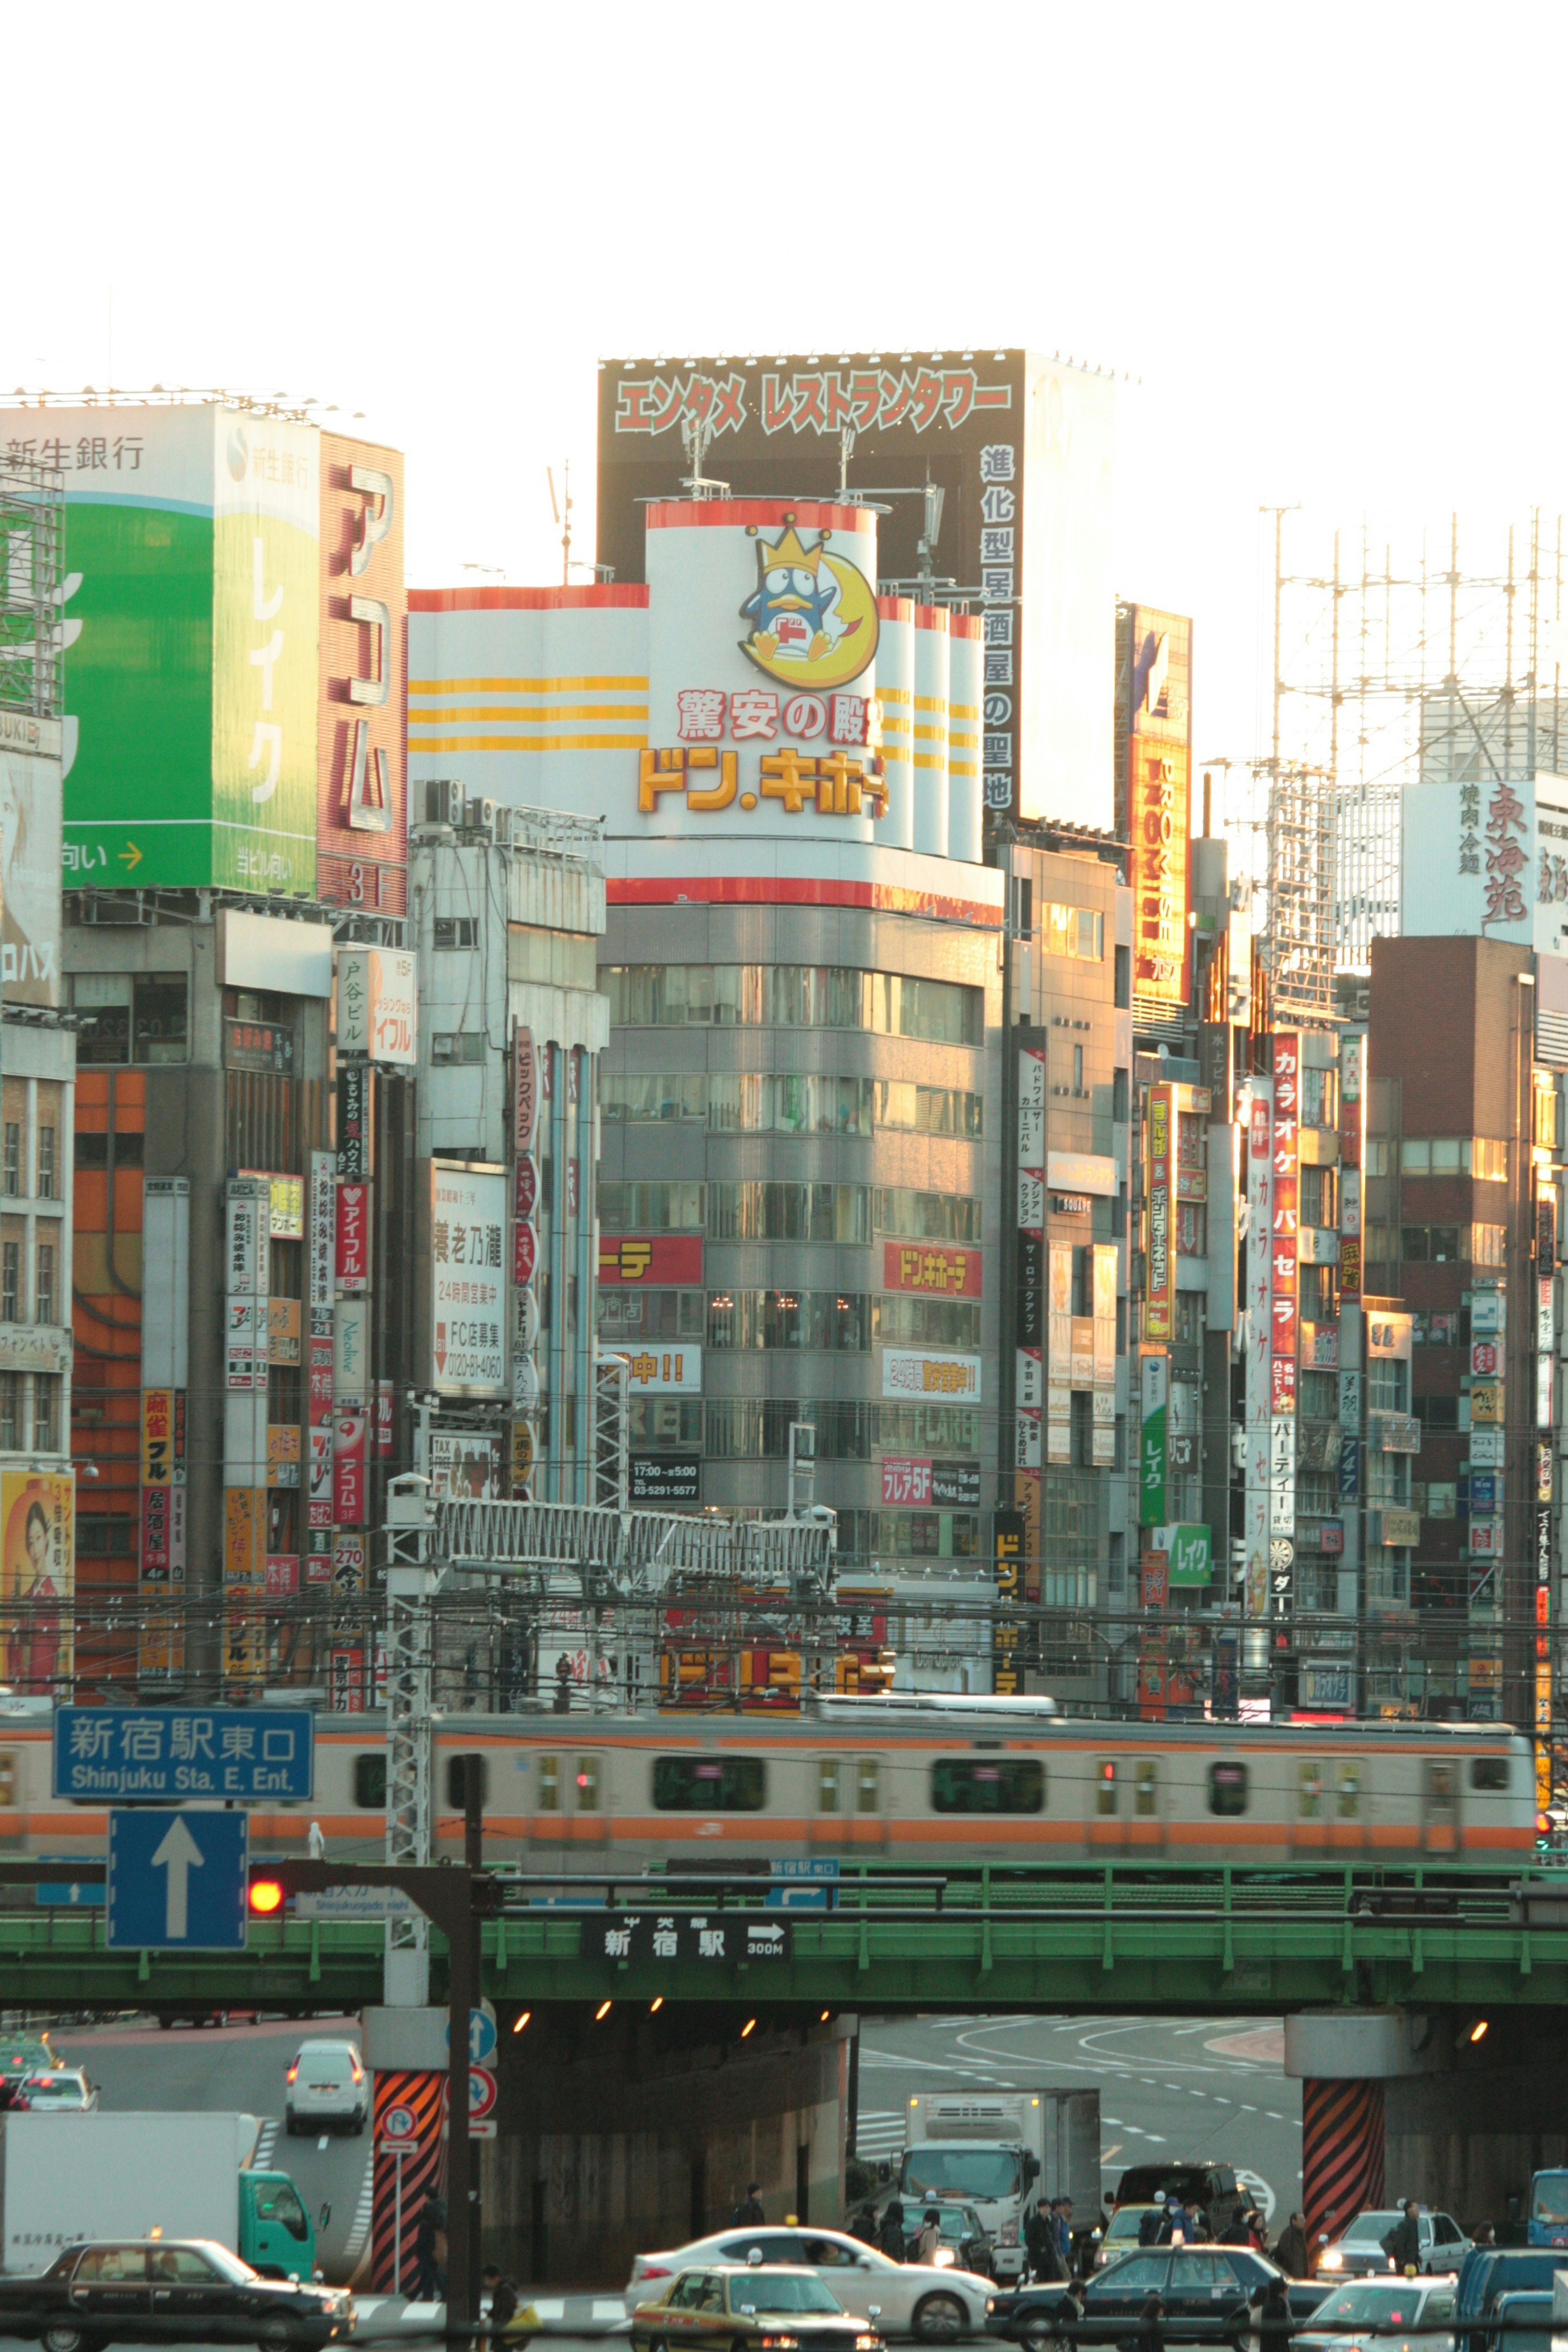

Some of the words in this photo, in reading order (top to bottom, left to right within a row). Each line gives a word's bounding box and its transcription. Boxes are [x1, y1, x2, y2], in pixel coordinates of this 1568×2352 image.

[615, 372, 746, 437] エンタメ
[762, 366, 1011, 435] レストランタワー
[252, 445, 310, 490] 新生銀行
[980, 444, 1016, 808] 進化型居酒屋の聖地
[247, 537, 284, 803] レイク
[347, 464, 394, 834] アコム
[1156, 757, 1175, 941] PROMISE
[1482, 782, 1529, 921] 東海苑
[349, 863, 391, 904] 3F
[344, 961, 364, 1040] 戸谷ビル
[1211, 1034, 1224, 1096] 水上ビル
[1033, 1065, 1042, 1133] バドワイザー
[344, 1083, 361, 1173] もみの気ハウス
[1021, 1097, 1030, 1153] カーニバル
[337, 1152, 346, 1173] 6F
[1020, 1183, 1029, 1225] クッション
[1031, 1181, 1040, 1209] アジア
[1274, 1052, 1297, 1324] カラオケパセラ
[343, 1207, 360, 1274] アイフル
[434, 1219, 502, 1268] 養老乃瀧
[344, 1279, 360, 1289] 5F
[439, 1281, 497, 1306] 24時間営業中
[1025, 1244, 1036, 1334] ザ・ロックアップ
[451, 1320, 499, 1348] FC店募集
[449, 1353, 501, 1379] 0120-81-4060
[1024, 1360, 1034, 1401] 手羽一郎
[1283, 1363, 1294, 1386] 名物
[435, 1440, 450, 1453] TAX
[1018, 1420, 1027, 1465] ひとめぼれ
[1146, 1439, 1162, 1489] レイク
[340, 1458, 356, 1506] アコム
[1274, 1422, 1291, 1510] パーティー
[1341, 1440, 1356, 1491] 747
[634, 1486, 697, 1495] 03-5291-5577
[147, 1491, 165, 1551] 居酒屋
[309, 1505, 331, 1525] たばこ
[340, 1511, 355, 1520] 3F
[1272, 1515, 1292, 1525] 貸切
[336, 1550, 363, 1564] 270
[1177, 1539, 1207, 1571] レイク
[69, 1716, 295, 1760] 新宿駅東口
[71, 1766, 166, 1793] Shinjuku
[175, 1767, 215, 1790] Sta.
[225, 1768, 244, 1790] E.
[253, 1768, 294, 1791] Ent.
[771, 1859, 811, 1875] 新宿駅
[604, 1929, 725, 1957] 新宿駅
[747, 1943, 783, 1955] 300M
